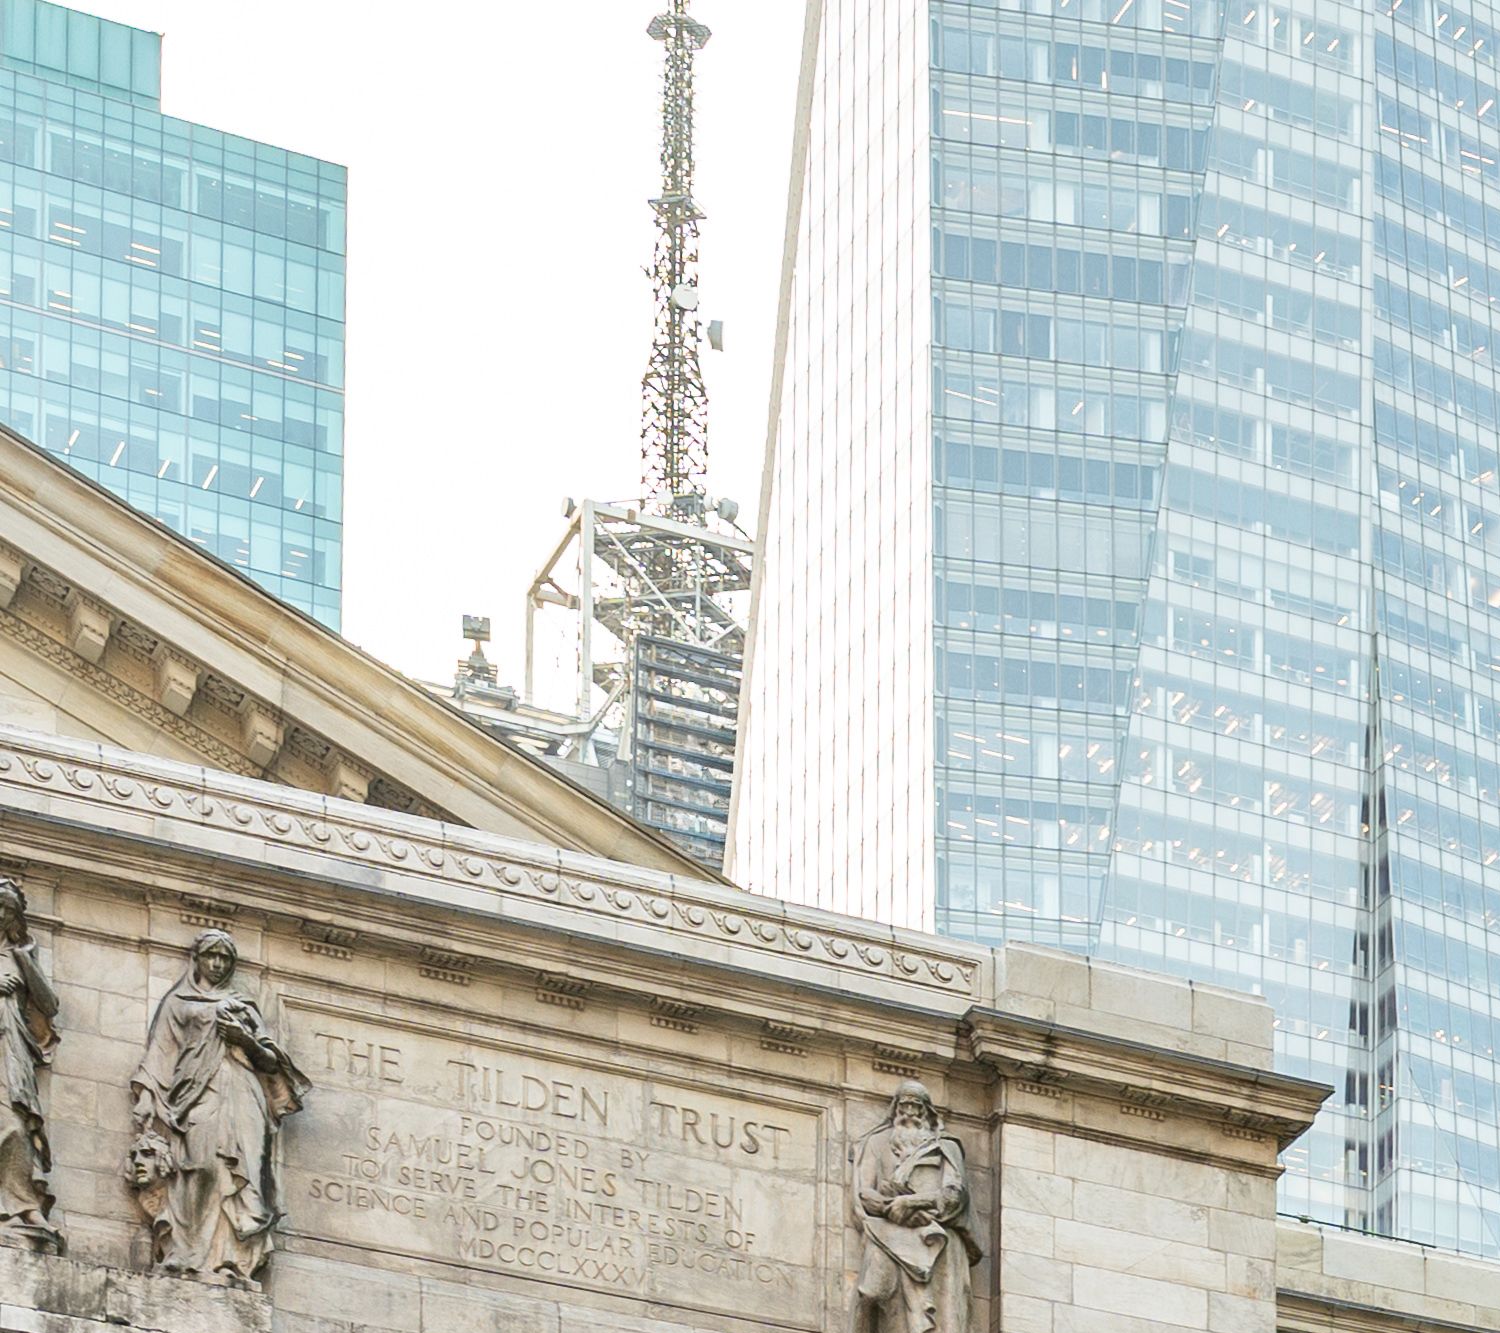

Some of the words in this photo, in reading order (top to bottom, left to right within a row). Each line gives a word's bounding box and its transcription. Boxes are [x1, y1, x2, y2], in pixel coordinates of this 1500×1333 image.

[314, 1032, 404, 1084] THE
[447, 1059, 609, 1127] TILDEN
[650, 1100, 793, 1161] TRUST
[461, 1116, 590, 1159] FOUNDED
[620, 1148, 651, 1172] BY
[342, 1153, 381, 1179] TO
[398, 1165, 477, 1199] SERVE
[496, 1183, 550, 1214] THE
[564, 1197, 708, 1244] INTERESTS
[723, 1229, 756, 1252] OF
[366, 1126, 496, 1174] SAMUEL
[511, 1156, 617, 1197] JONES
[635, 1177, 743, 1223] TILDEN
[308, 1178, 427, 1219] SCIENCE
[442, 1205, 499, 1231] AND
[512, 1216, 635, 1258] POPULAR
[649, 1243, 795, 1290] EDUCATION
